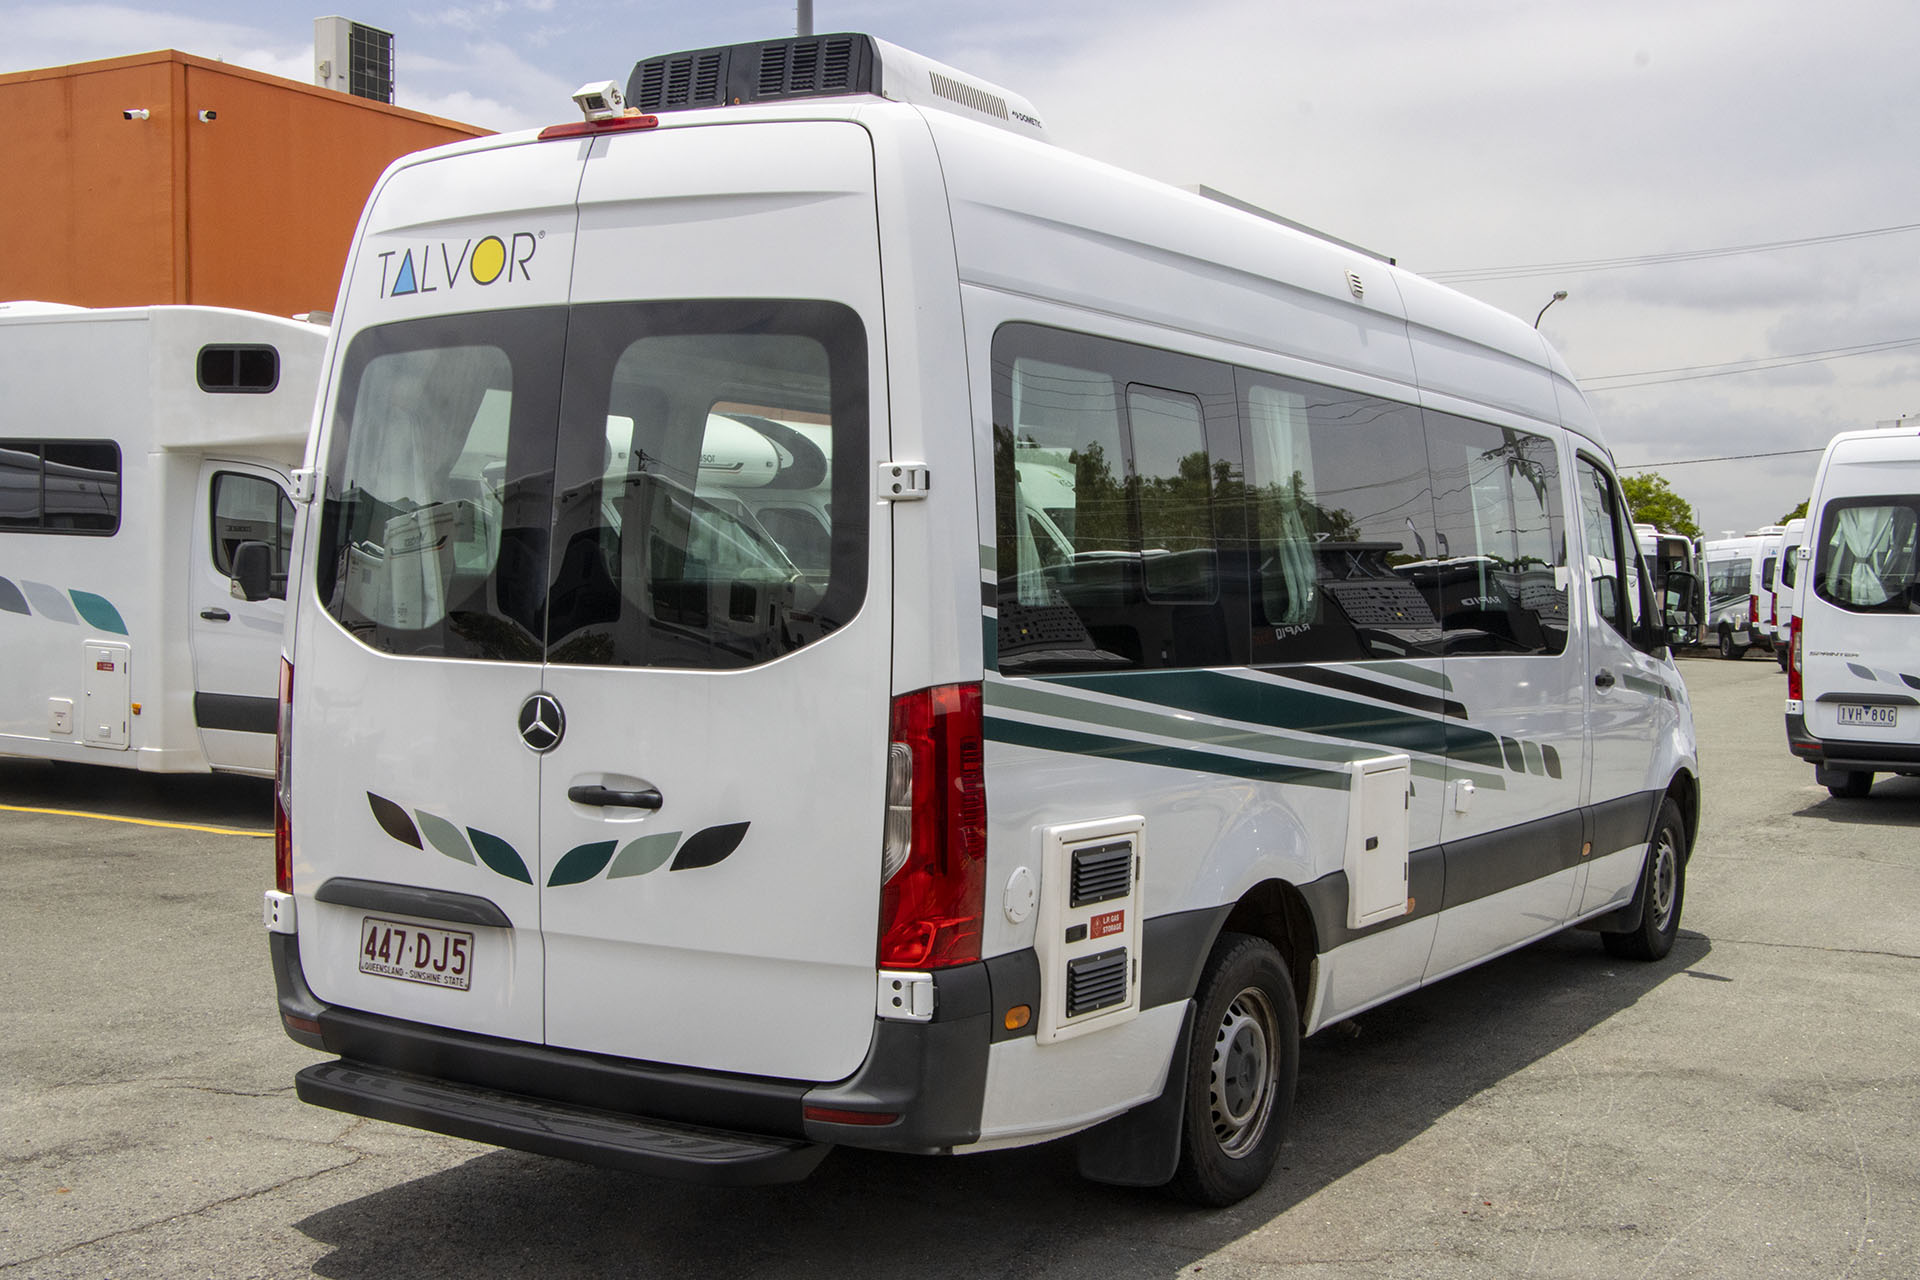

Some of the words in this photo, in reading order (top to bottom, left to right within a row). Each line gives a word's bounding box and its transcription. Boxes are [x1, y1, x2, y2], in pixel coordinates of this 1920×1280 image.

[1841, 707, 1862, 721] 1VH
[364, 961, 404, 976] QUEENSLAND
[409, 969, 442, 984] SUNSHINE
[443, 975, 465, 988] STATE
